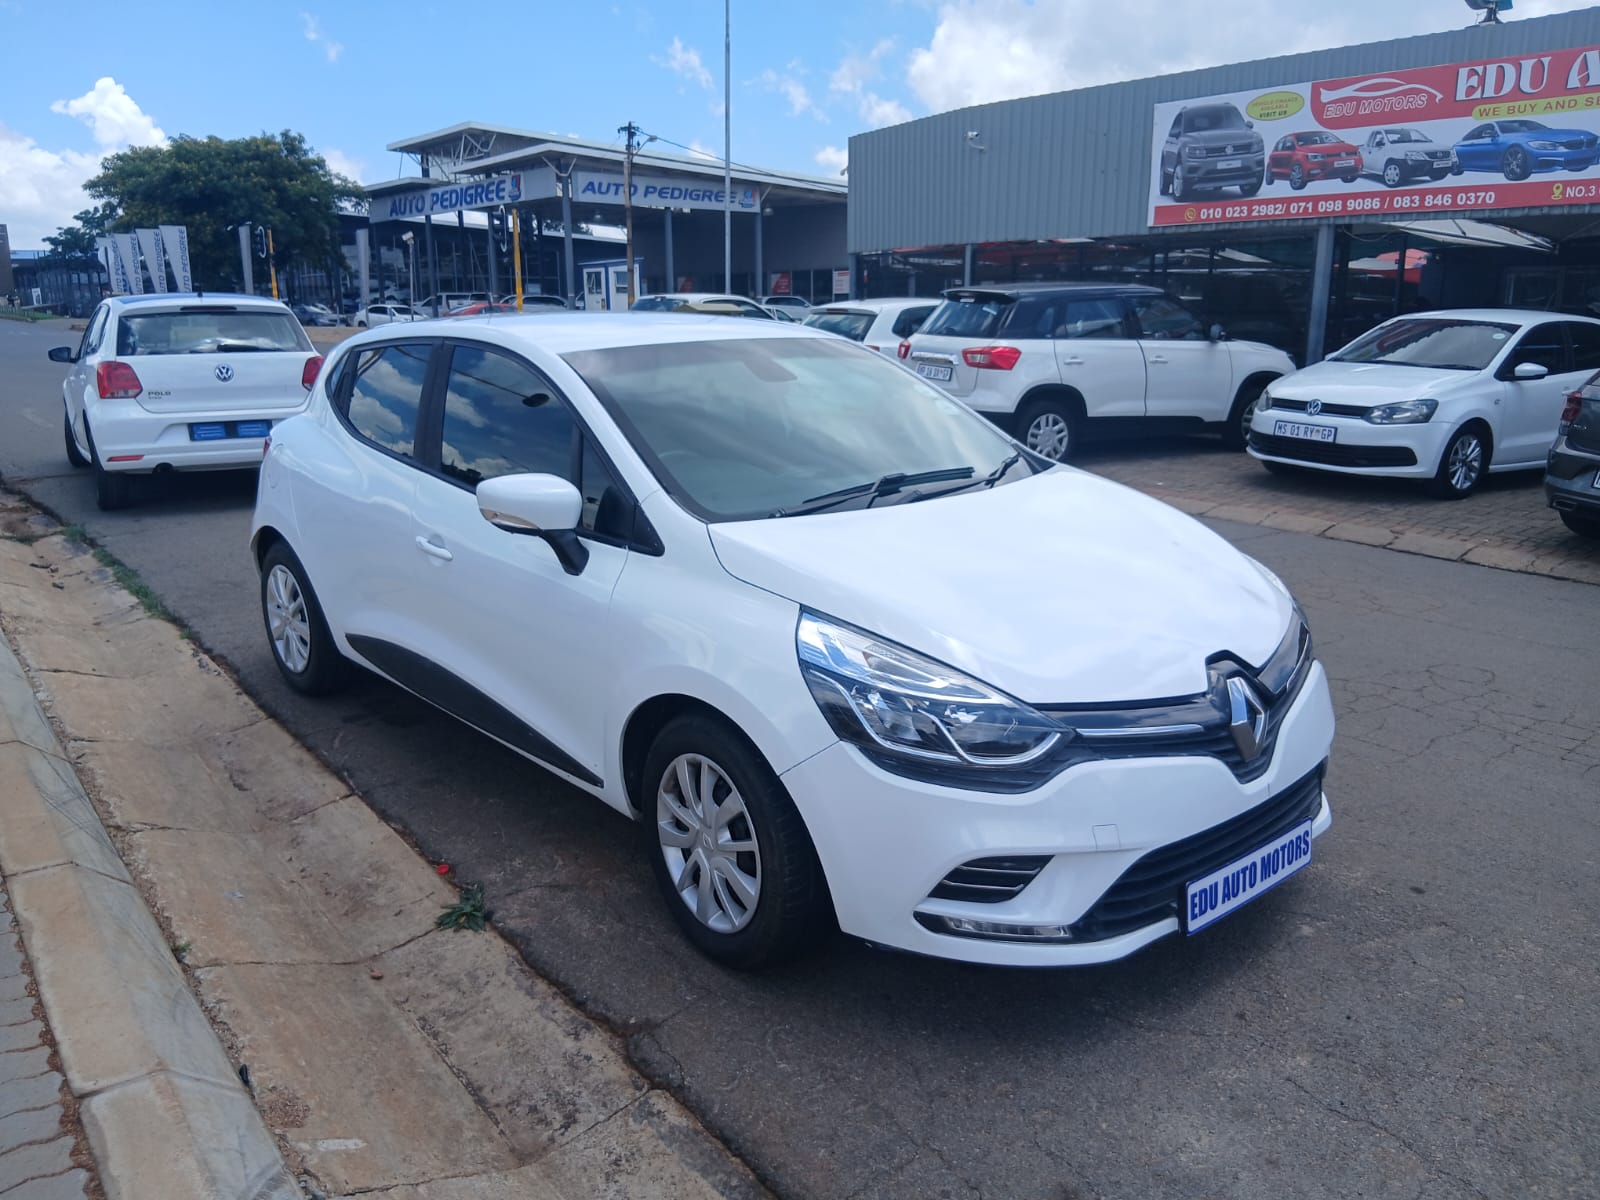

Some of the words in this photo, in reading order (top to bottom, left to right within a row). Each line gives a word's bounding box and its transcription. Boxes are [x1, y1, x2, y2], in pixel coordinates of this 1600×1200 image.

[1456, 57, 1551, 101] EDU
[1323, 102, 1355, 119] EDU
[1359, 93, 1427, 115] MOTORS
[1478, 107, 1501, 117] WE
[1506, 103, 1537, 115] BUY
[1543, 99, 1578, 111] AND
[389, 194, 426, 217] AUTO
[430, 179, 506, 212] PEDIGREE
[1200, 208, 1222, 219] 010
[1225, 205, 1248, 218] 023
[1290, 202, 1313, 214] 071
[1318, 200, 1343, 213] 098
[1347, 197, 1380, 210] 9086
[1393, 195, 1420, 208] 083
[1424, 193, 1452, 206] 846
[1456, 191, 1495, 205] 0370
[1565, 185, 1596, 198] NO.3
[1277, 423, 1288, 435] MS
[1290, 424, 1300, 437] 01
[1303, 426, 1316, 438] RY
[1320, 428, 1333, 440] GP
[1190, 881, 1219, 922] EDU
[1221, 860, 1258, 905] AUTO
[1260, 829, 1310, 882] MOTORS
